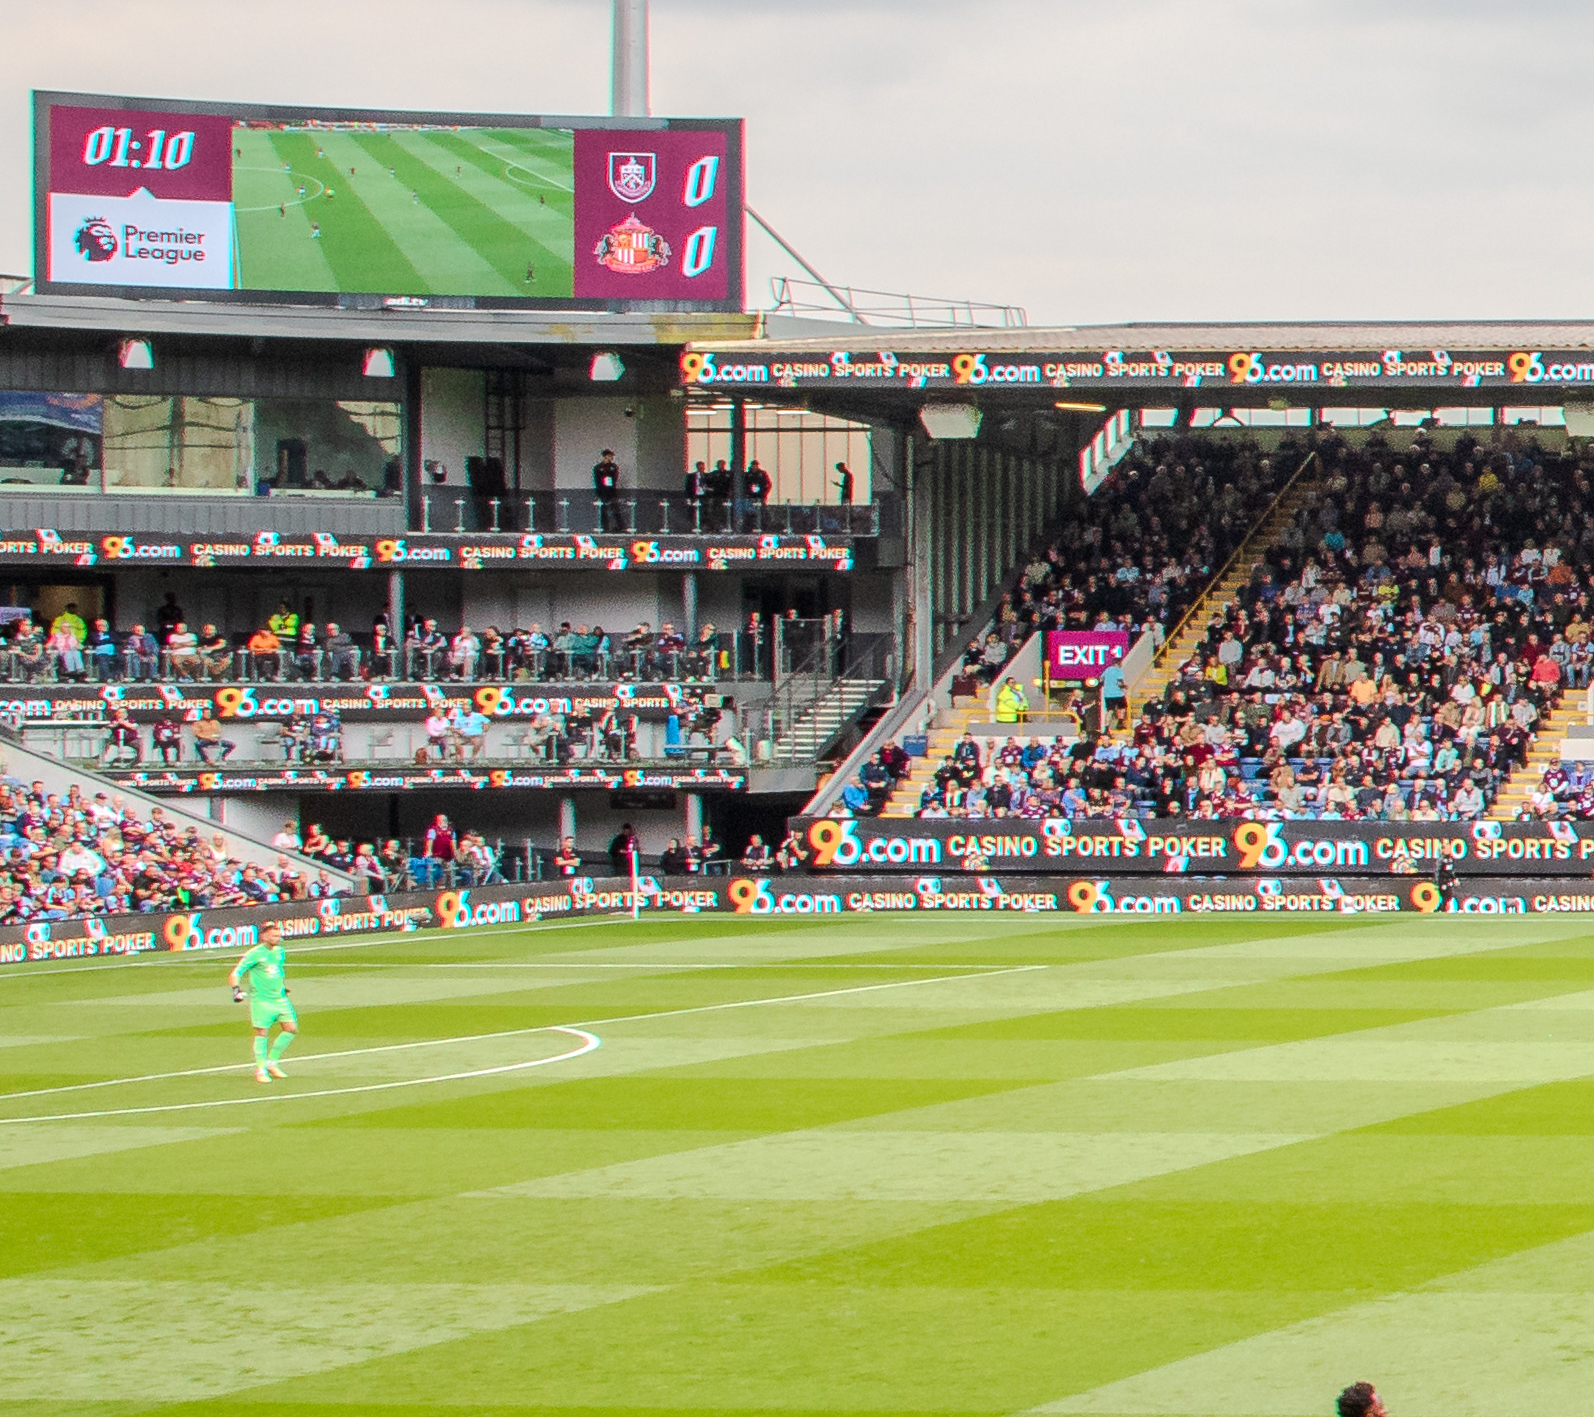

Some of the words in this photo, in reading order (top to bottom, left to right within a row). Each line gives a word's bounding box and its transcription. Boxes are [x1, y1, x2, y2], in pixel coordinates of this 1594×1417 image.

[82, 126, 194, 169] 01:10
[682, 156, 718, 207] 0
[124, 225, 205, 245] Premier
[125, 244, 205, 264] League
[681, 226, 717, 277] 0
[682, 353, 767, 383] 96.com
[772, 364, 829, 376] CASINO
[834, 364, 897, 376] SPORTS
[899, 363, 948, 376] POKER
[1229, 351, 1316, 382] 96.com
[1322, 362, 1380, 375] CASINO
[1385, 362, 1450, 375] SPORTS
[1453, 361, 1503, 374] POKER
[43, 541, 95, 555] POKER
[102, 536, 181, 558] 96.com
[191, 544, 250, 556] CASINO
[255, 544, 314, 557] SPORTS
[320, 545, 368, 557] POKER
[632, 542, 699, 563] 96.com
[1058, 646, 1107, 666] EXIT
[213, 686, 318, 717] 96.com
[474, 687, 571, 716] 96.com
[808, 819, 942, 866] 96.com
[946, 835, 1037, 858] CASINO
[1044, 835, 1140, 858] SPORTS
[1148, 835, 1227, 858] POKER
[1234, 822, 1368, 868] 96.com
[1475, 837, 1572, 860] SPORTS
[436, 889, 520, 929] 96.com
[525, 894, 572, 914] CASINO
[659, 890, 718, 907] POKER
[727, 878, 843, 914] 96.com
[849, 893, 916, 910] CASINO
[922, 893, 994, 910] SPORTS
[999, 893, 1058, 910] POKER
[1067, 880, 1181, 914] 96.com
[104, 932, 156, 954] POKER
[163, 914, 258, 952] 96.com
